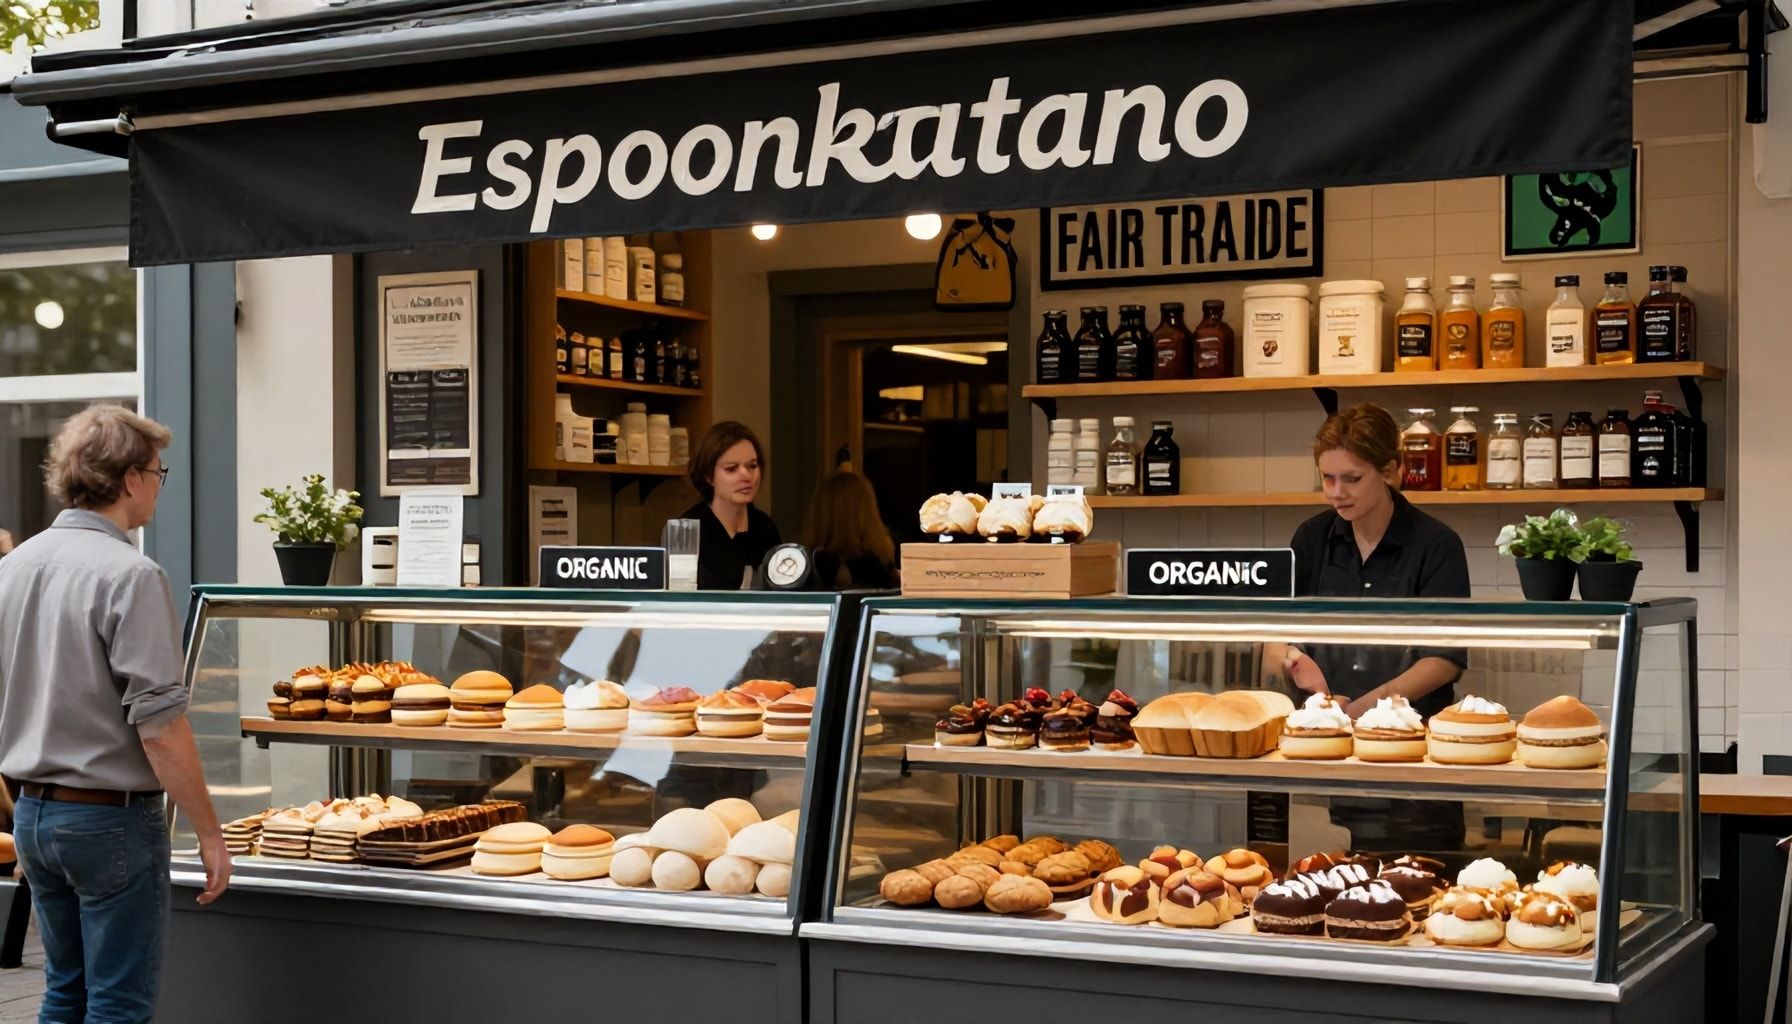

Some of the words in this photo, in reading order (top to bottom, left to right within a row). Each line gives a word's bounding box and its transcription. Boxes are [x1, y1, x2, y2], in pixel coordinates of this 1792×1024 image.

[411, 77, 1249, 233] Espoonkatano
[1058, 208, 1144, 272] FAIR
[1155, 197, 1308, 265] TRAIDE
[556, 556, 649, 580] ORGANIC
